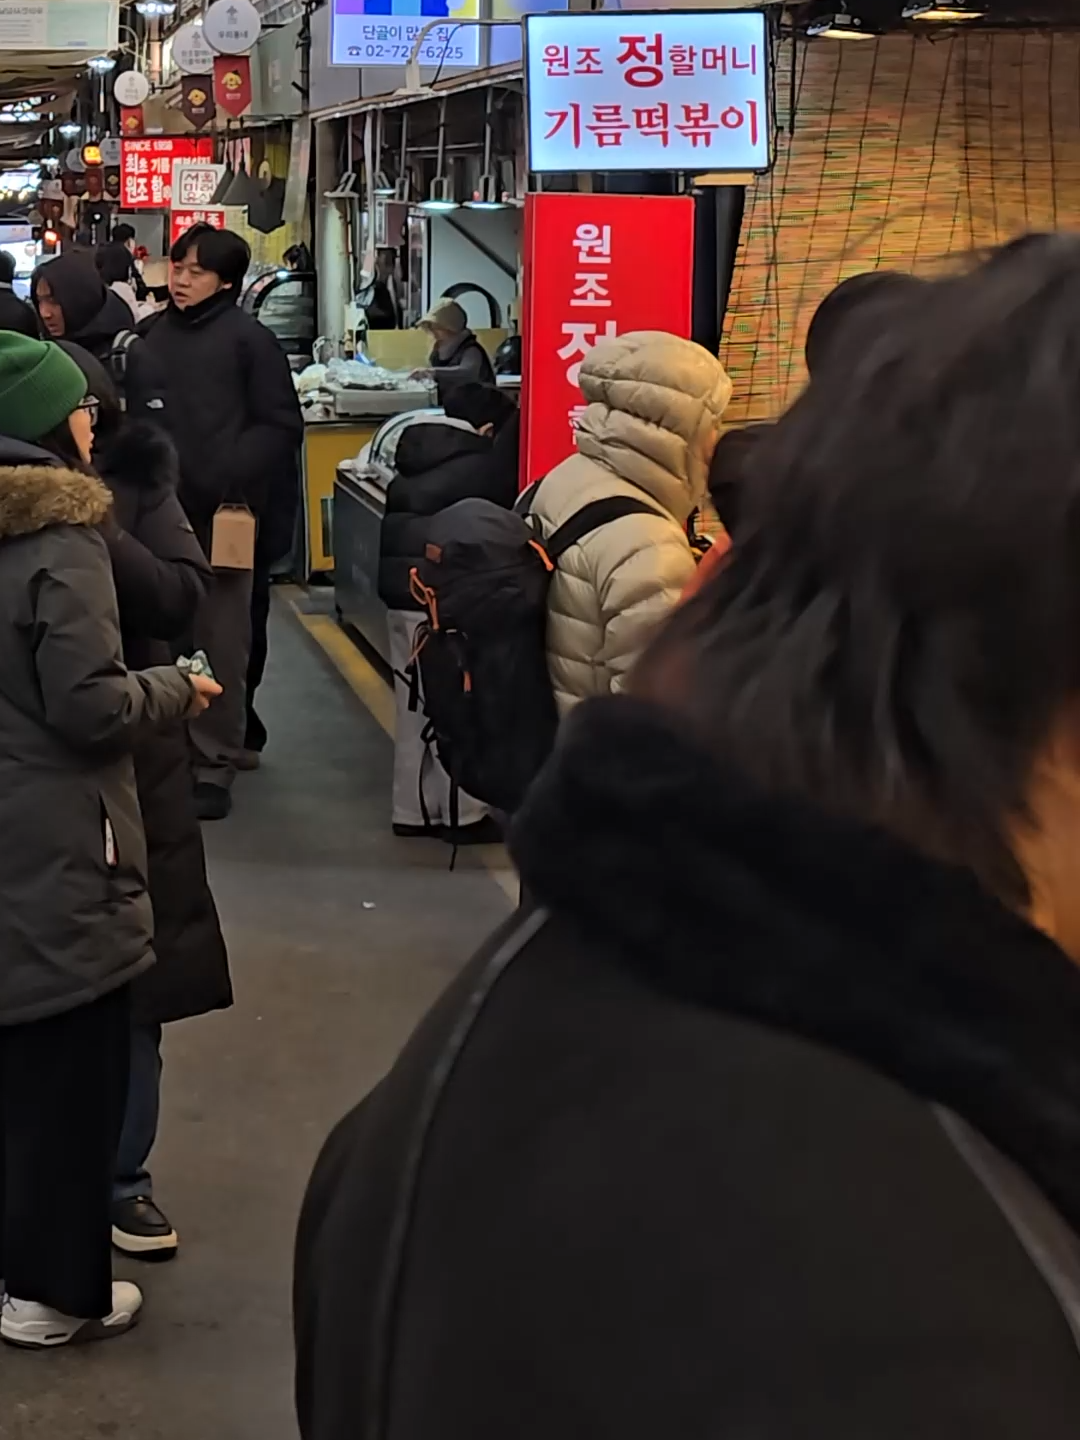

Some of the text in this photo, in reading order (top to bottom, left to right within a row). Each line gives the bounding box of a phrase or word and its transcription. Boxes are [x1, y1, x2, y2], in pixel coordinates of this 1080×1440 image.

[362, 25, 402, 41] 단골이
[436, 27, 449, 42] 집
[542, 44, 604, 77] 원조
[544, 100, 759, 150] 기름떡볶이
[571, 223, 612, 307] 원조
